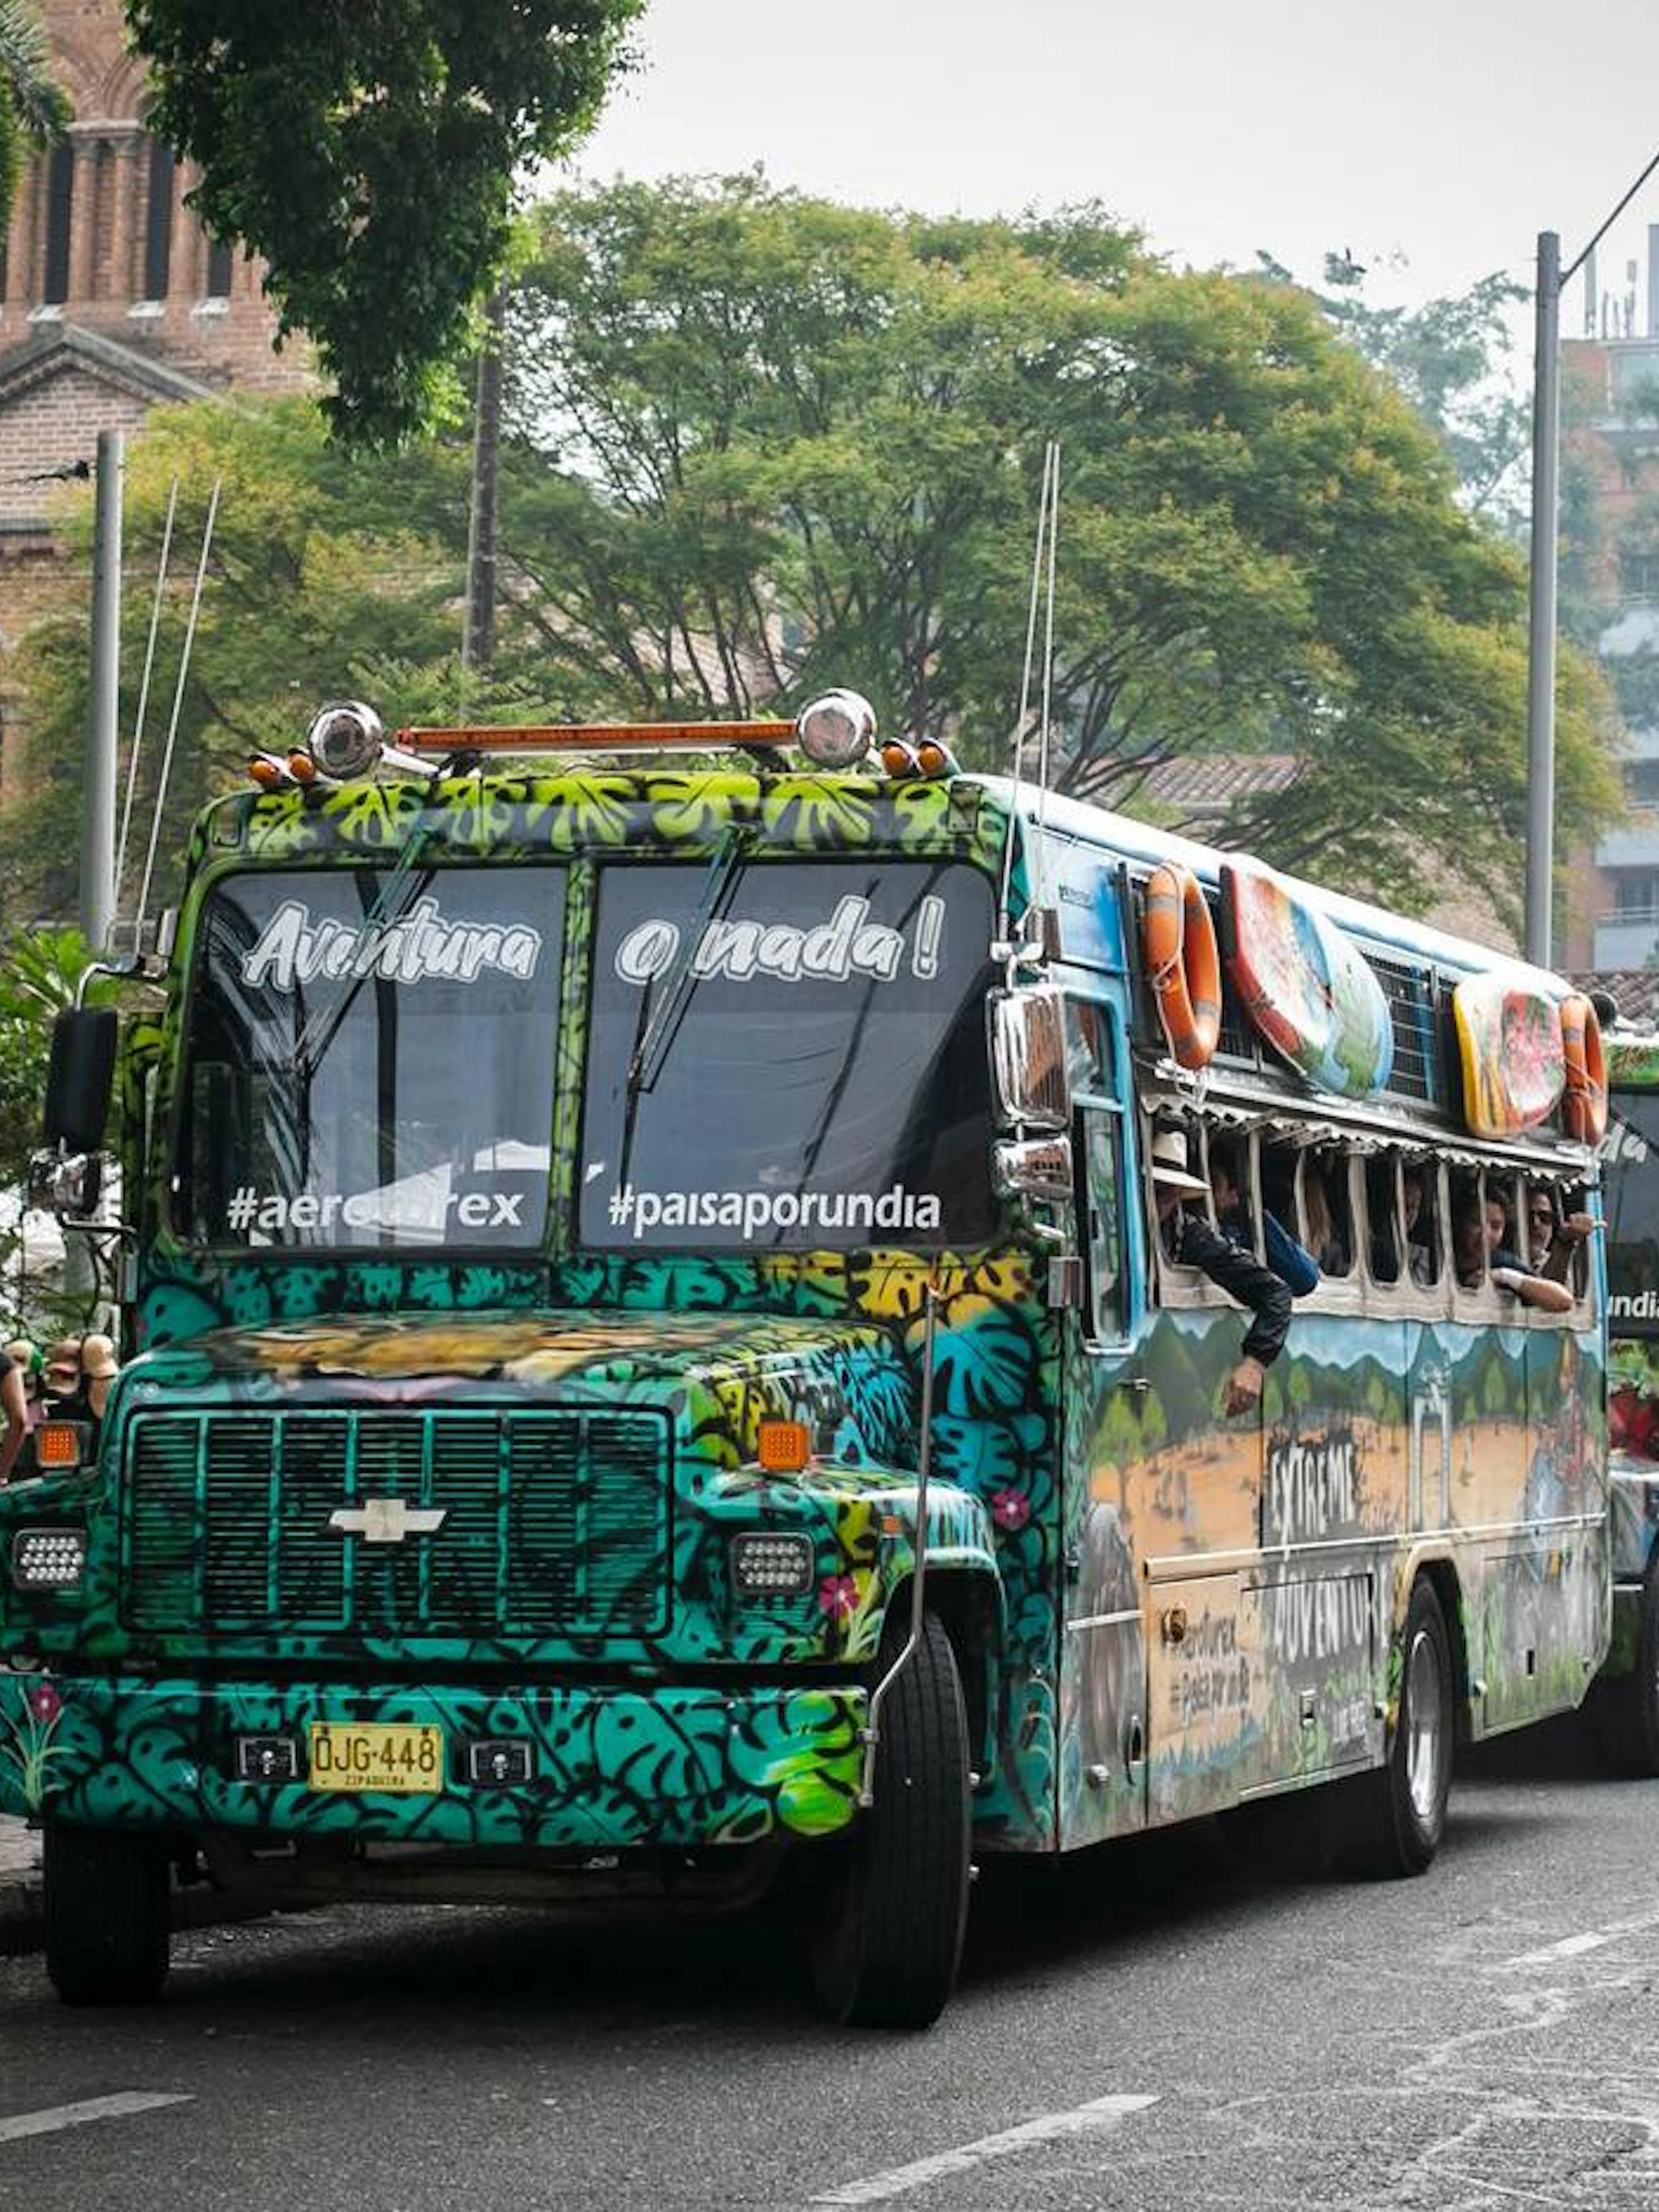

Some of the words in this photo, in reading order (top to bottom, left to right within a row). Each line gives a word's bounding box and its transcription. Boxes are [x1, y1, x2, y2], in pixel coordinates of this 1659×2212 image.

[242, 896, 542, 992] Aventura
[615, 919, 680, 984] o
[227, 1187, 524, 1230] #aerorex
[1271, 1441, 1355, 1561] EXTREME
